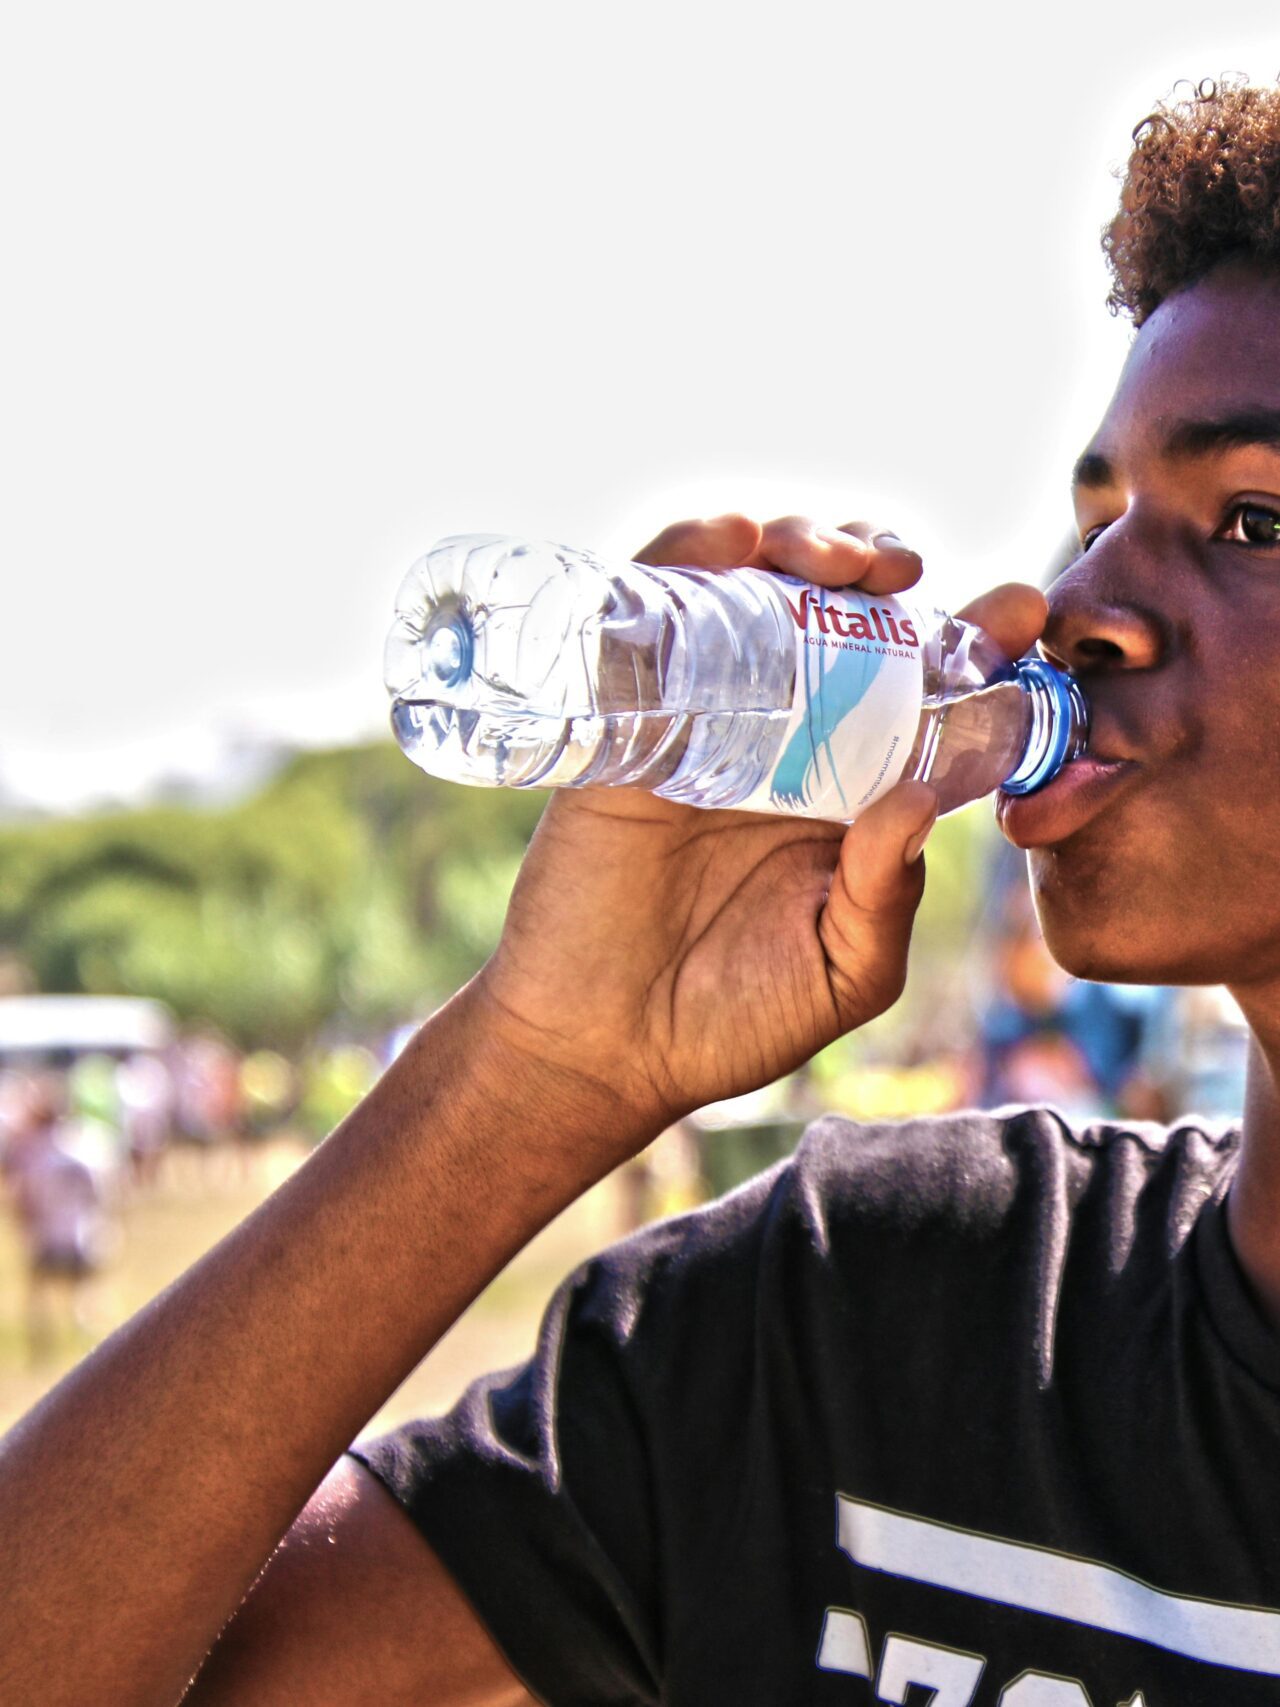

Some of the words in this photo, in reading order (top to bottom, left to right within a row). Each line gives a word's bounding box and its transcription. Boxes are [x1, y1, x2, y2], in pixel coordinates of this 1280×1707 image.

[785, 589, 919, 647] Vitalis
[831, 640, 873, 654] MINERAL
[875, 647, 916, 660] NATURAL
